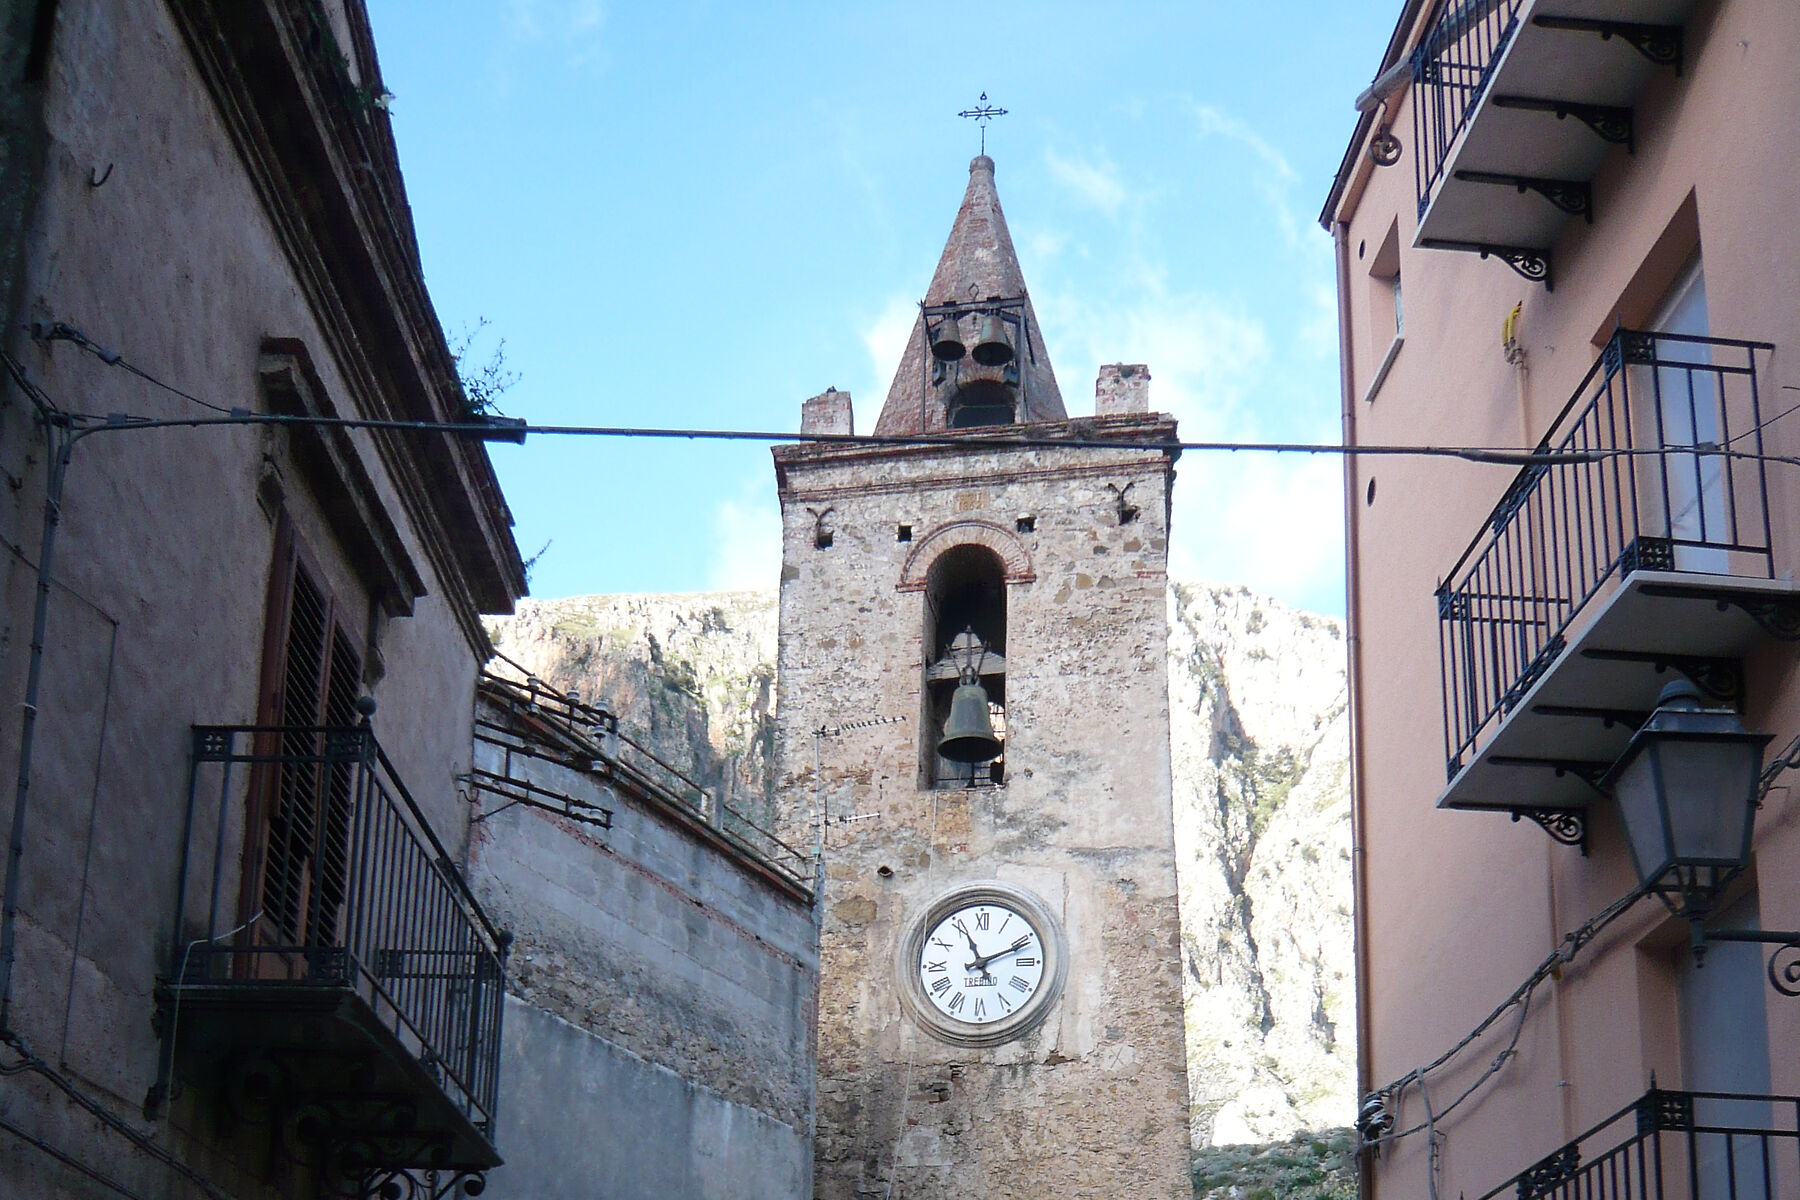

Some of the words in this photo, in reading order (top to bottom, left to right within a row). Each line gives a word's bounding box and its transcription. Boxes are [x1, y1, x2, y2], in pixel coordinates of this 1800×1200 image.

[976, 913, 989, 930] XII
[999, 918, 1009, 934] I
[934, 938, 953, 952] X
[928, 961, 947, 972] IX
[1016, 958, 1034, 967] III
[964, 977, 997, 987] TREBINO
[975, 998, 986, 1016] VI
[998, 993, 1011, 1009] V
